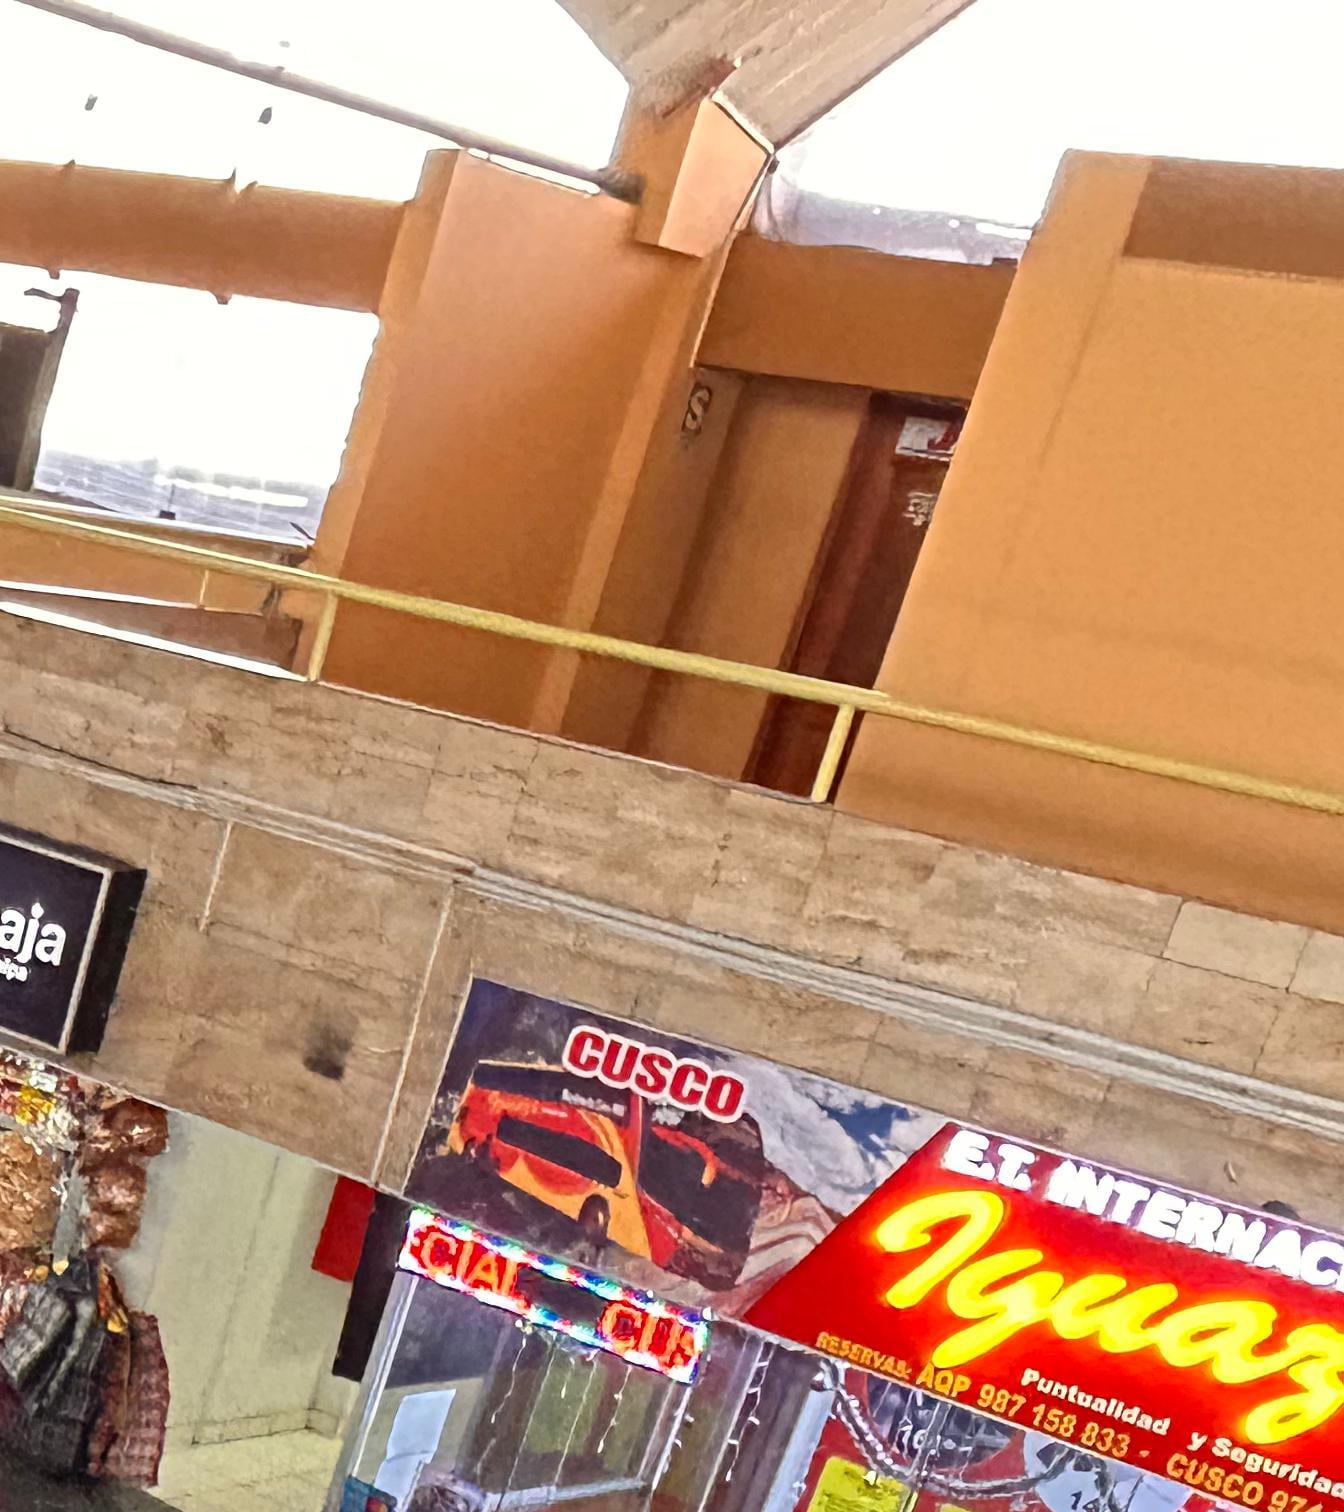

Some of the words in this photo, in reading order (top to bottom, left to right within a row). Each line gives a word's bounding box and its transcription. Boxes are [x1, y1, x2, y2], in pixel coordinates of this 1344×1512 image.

[563, 1026, 747, 1121] CUSCO
[1045, 1160, 1344, 1291] INTERNAC
[916, 1360, 972, 1398] AQP
[976, 1384, 1027, 1418] 987
[1032, 1403, 1077, 1438] 158
[1081, 1421, 1131, 1458] 833
[1166, 1453, 1265, 1506] CUSCO
[1020, 1366, 1172, 1437] Puntualidad
[1186, 1431, 1209, 1452] y
